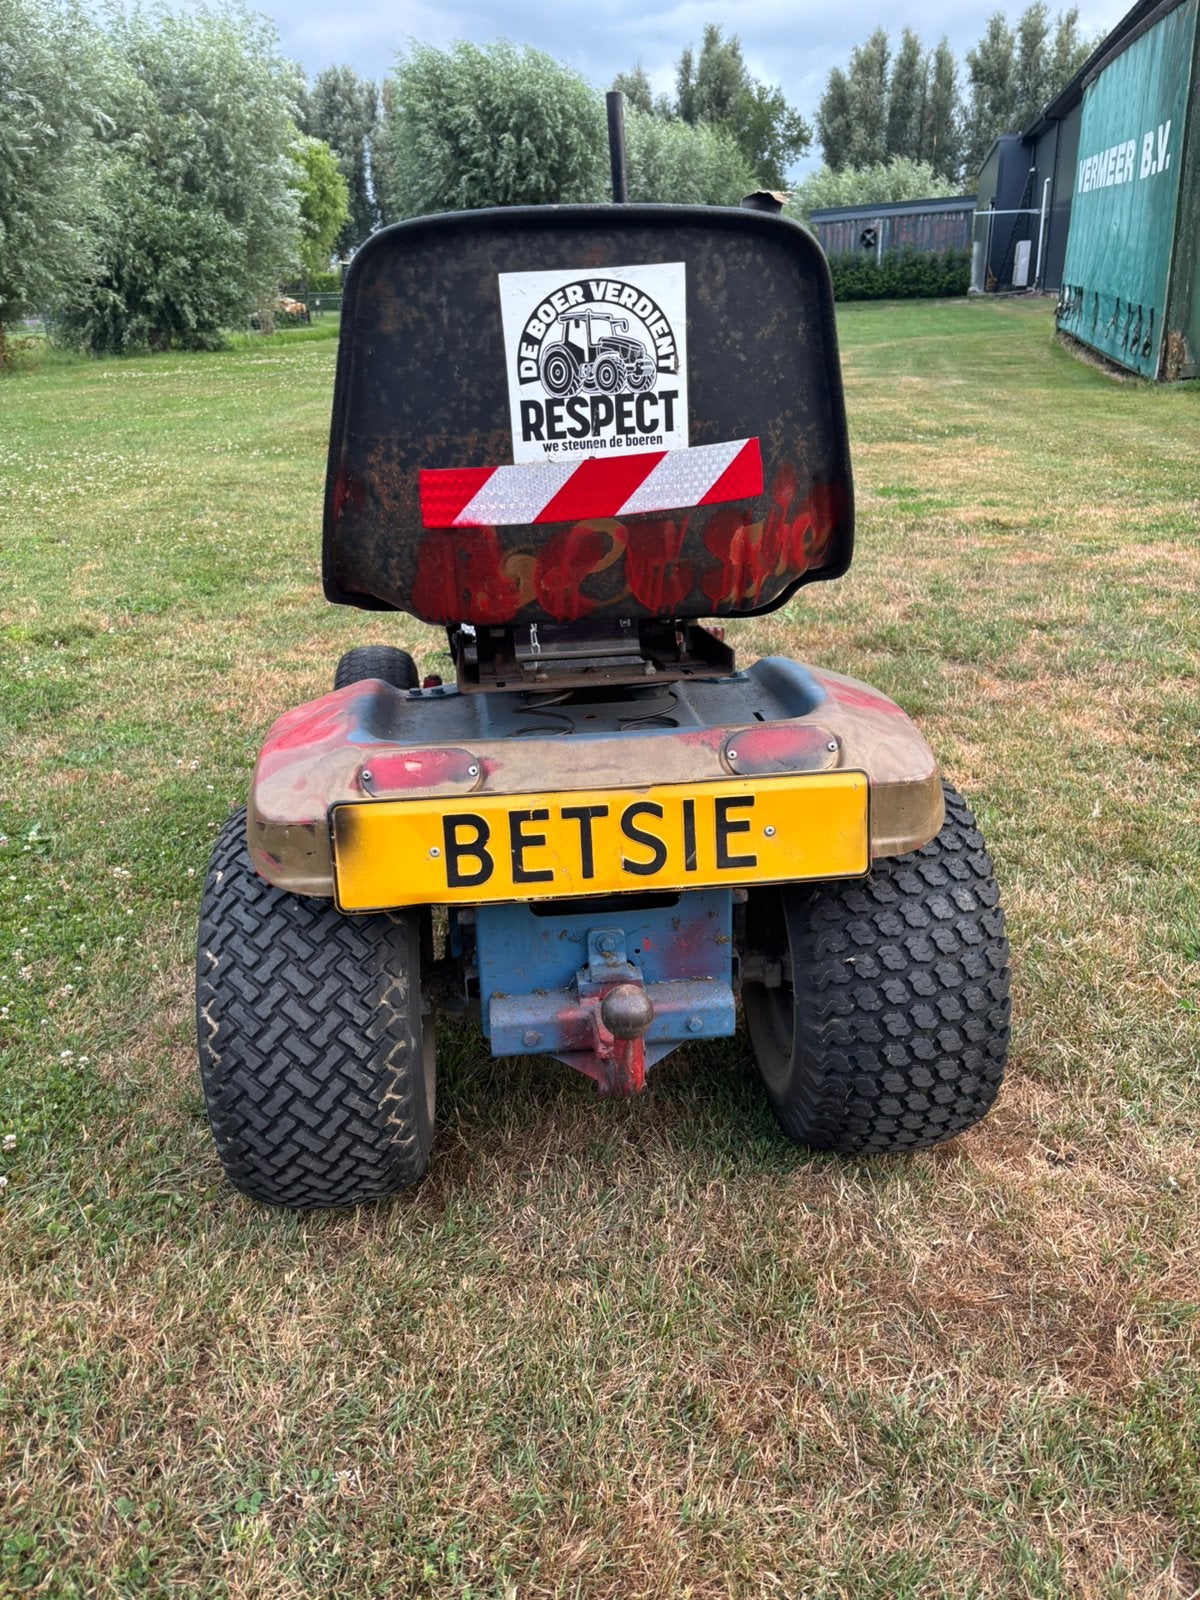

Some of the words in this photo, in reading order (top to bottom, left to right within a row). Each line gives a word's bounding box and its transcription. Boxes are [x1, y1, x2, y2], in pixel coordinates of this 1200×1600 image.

[1078, 139, 1136, 193] VERMEER
[1140, 120, 1171, 180] B.V.
[526, 284, 586, 341] BOER
[589, 281, 676, 371] VERDIENT
[520, 342, 539, 378] DE
[520, 390, 679, 442] RESPECT
[543, 441, 559, 453] we
[562, 437, 607, 451] steunen
[609, 435, 623, 448] de
[625, 434, 663, 446] boeren
[442, 795, 757, 888] BETSIE
